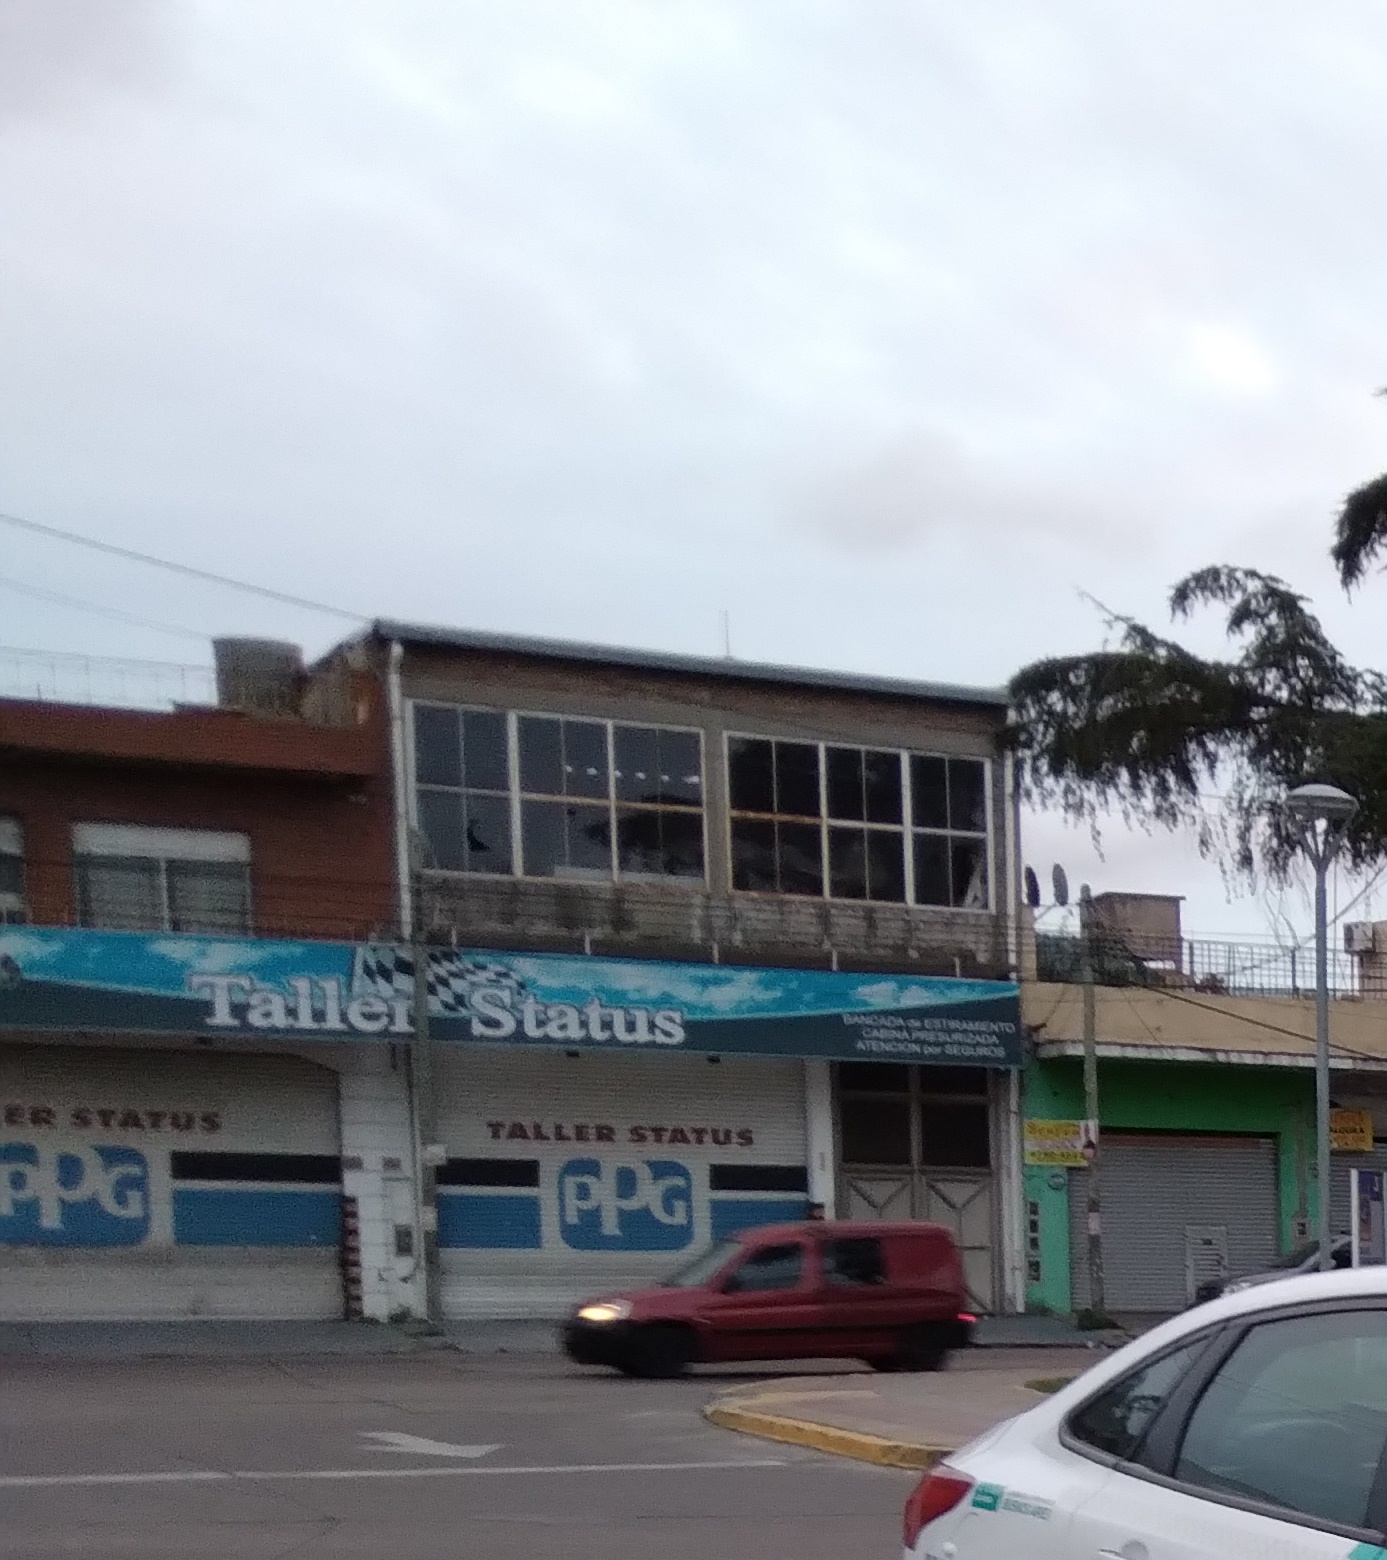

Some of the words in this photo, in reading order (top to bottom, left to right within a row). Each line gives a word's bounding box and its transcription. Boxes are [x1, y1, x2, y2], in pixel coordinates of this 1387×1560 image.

[188, 973, 416, 1033] Taller
[469, 987, 687, 1045] Status
[70, 1106, 223, 1132] STATUS
[486, 1121, 617, 1143] TALLER
[628, 1125, 755, 1147] STATUS
[563, 1159, 691, 1236] PPG
